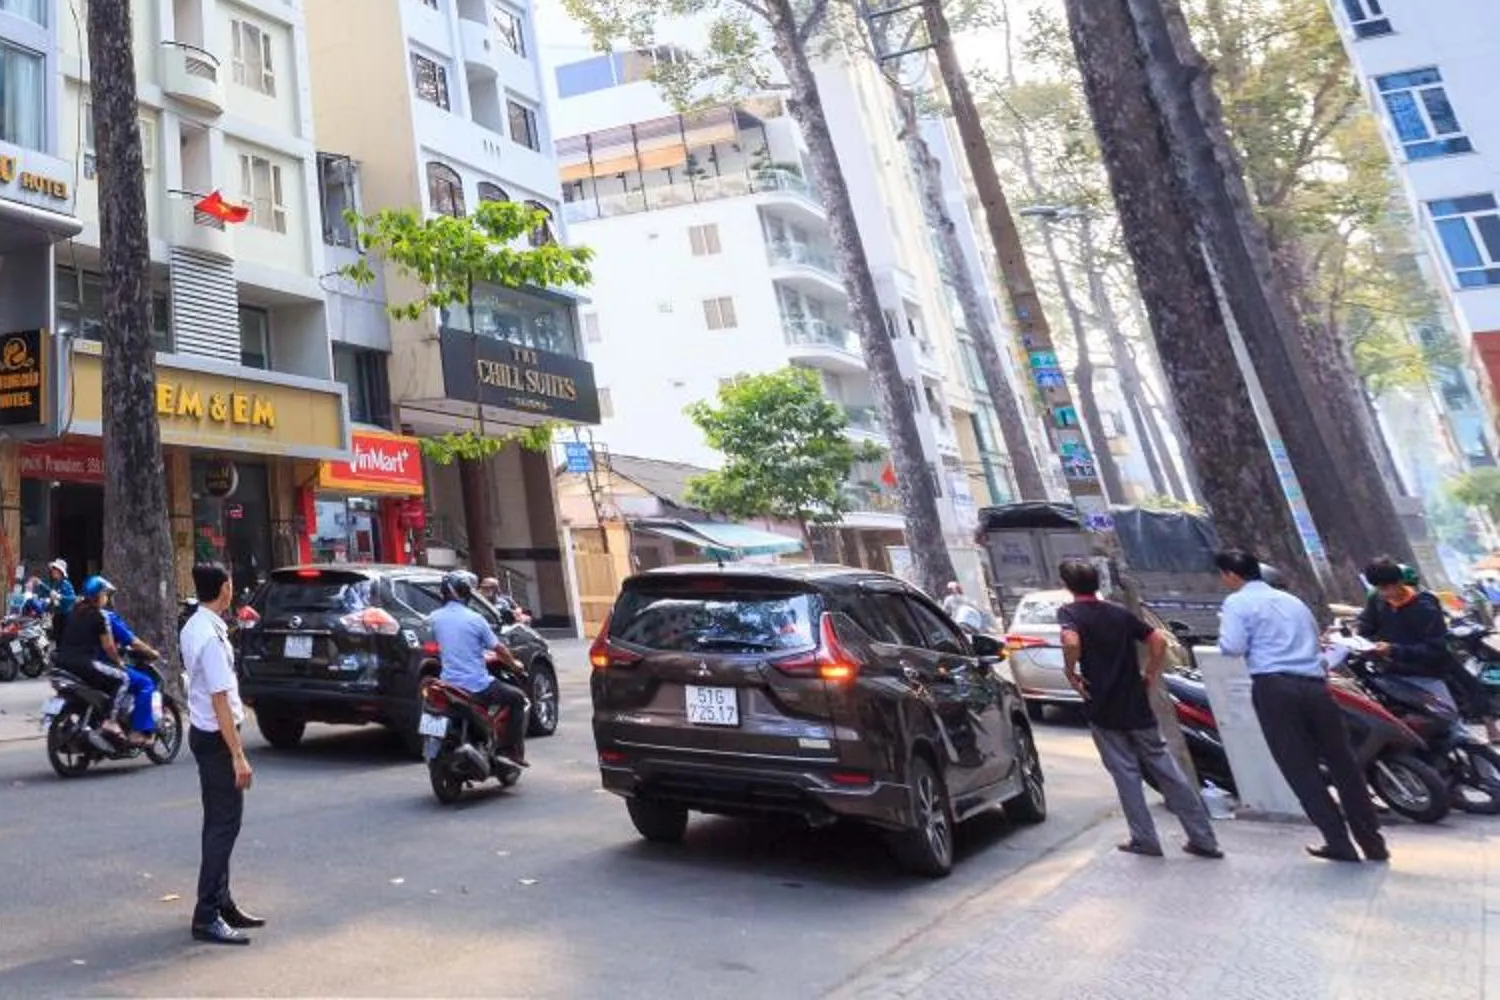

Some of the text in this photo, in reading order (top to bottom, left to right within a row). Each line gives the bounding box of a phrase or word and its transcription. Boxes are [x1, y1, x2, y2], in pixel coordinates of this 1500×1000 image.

[19, 171, 70, 201] HOTEL
[476, 359, 577, 401] CHILL SUITES
[210, 391, 228, 422] &
[231, 393, 276, 430] EM
